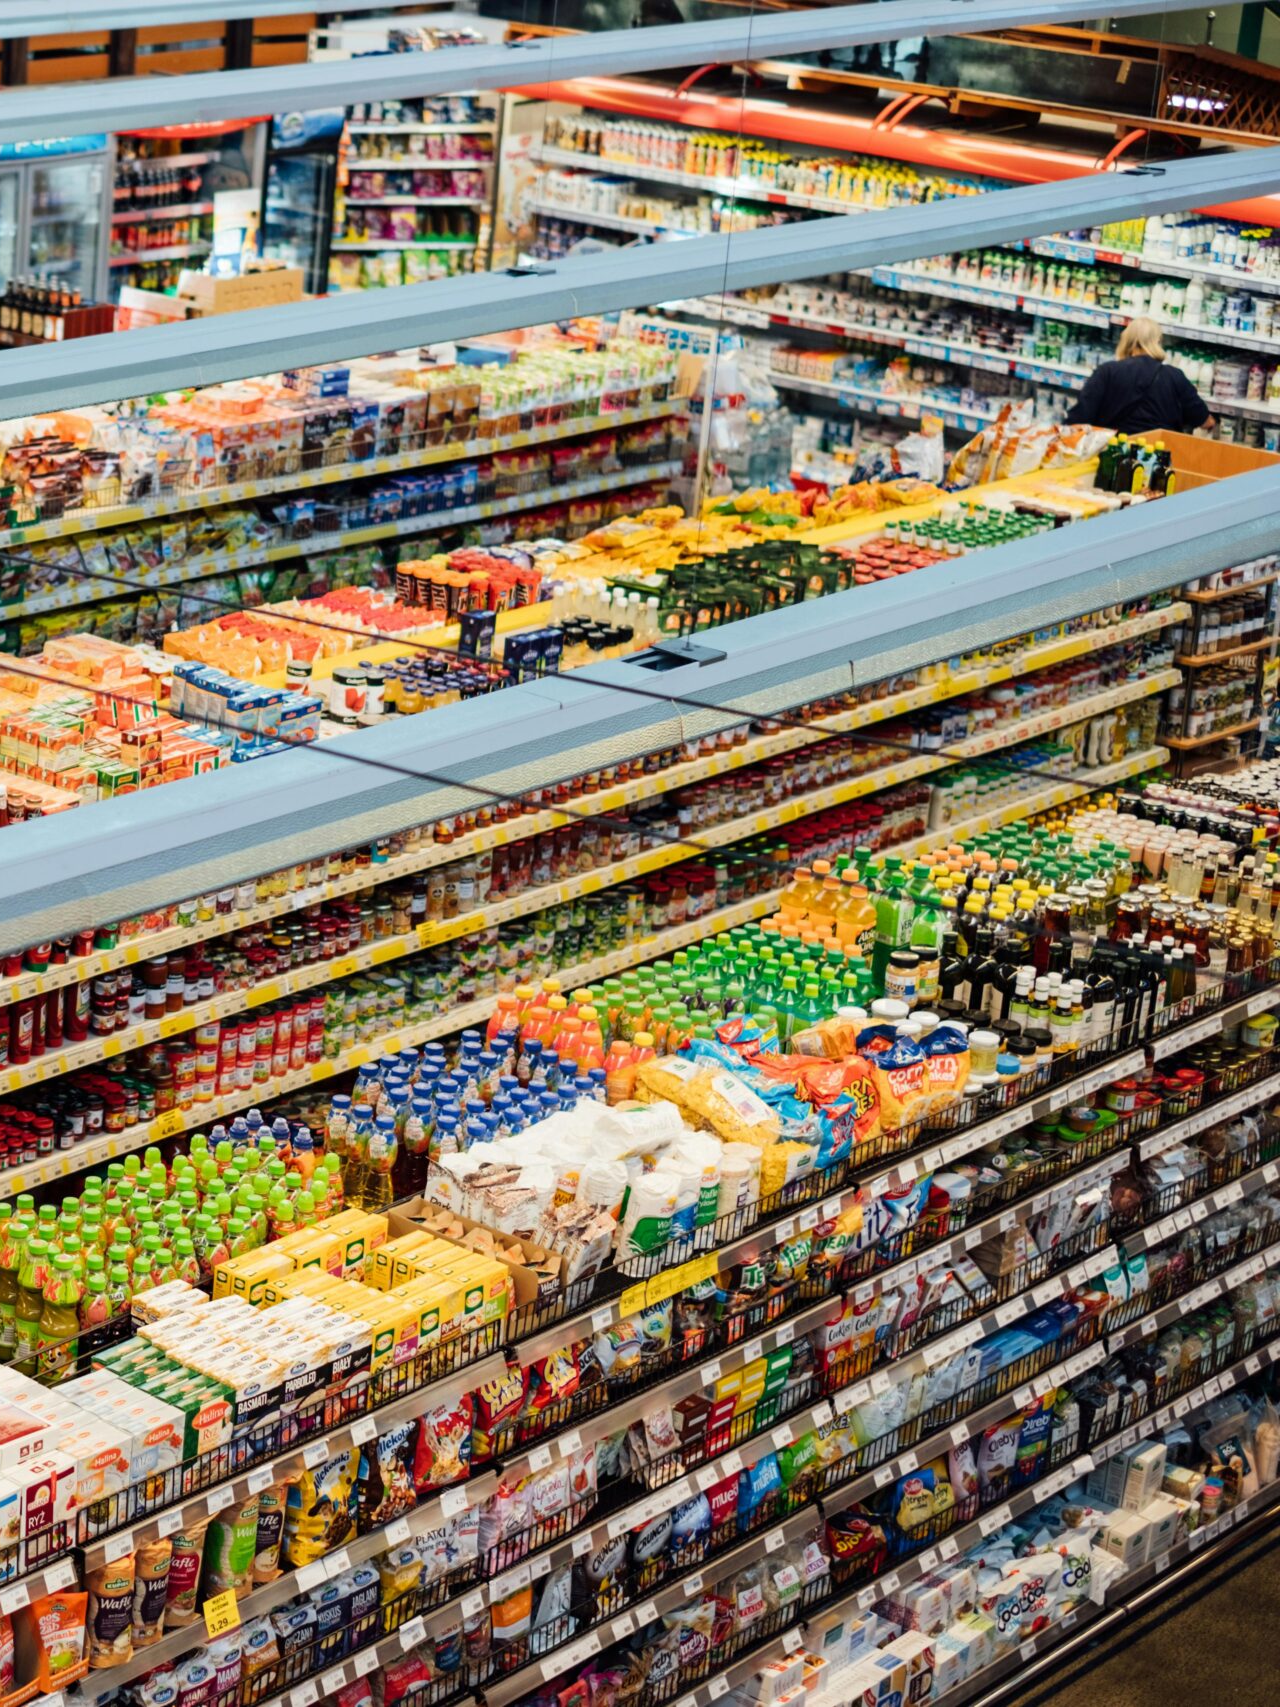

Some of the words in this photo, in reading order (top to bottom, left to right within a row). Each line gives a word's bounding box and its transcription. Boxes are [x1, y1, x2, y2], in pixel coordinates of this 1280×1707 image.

[887, 1065, 923, 1083] corn
[893, 1079, 923, 1096] flakes
[237, 1393, 268, 1415] BASMATI
[198, 1407, 225, 1424] Halina
[148, 1426, 172, 1442] Halina
[94, 1452, 117, 1467] Halina
[210, 1617, 229, 1633] 3,29
